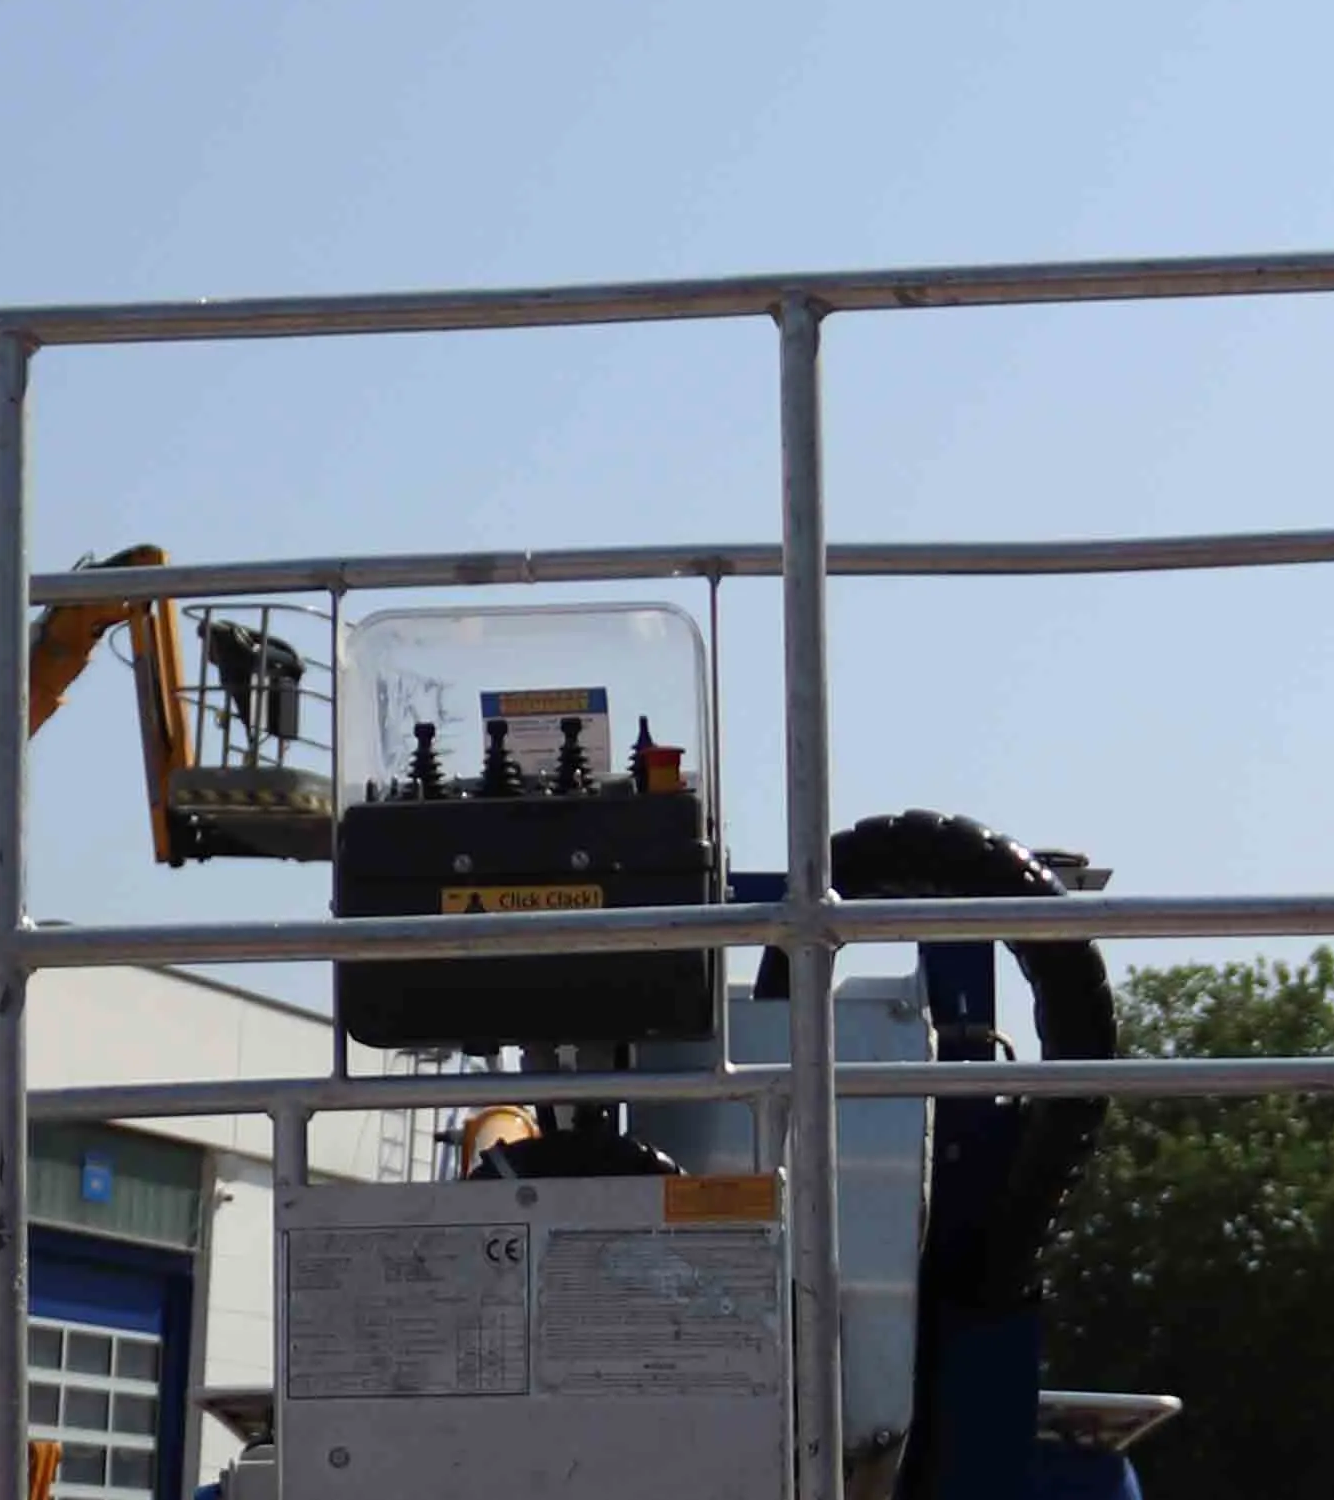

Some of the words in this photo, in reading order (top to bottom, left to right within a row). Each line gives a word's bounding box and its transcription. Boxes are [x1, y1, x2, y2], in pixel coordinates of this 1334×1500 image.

[499, 891, 540, 909] Click
[547, 890, 598, 908] Clack!
[485, 1237, 521, 1264] CE
